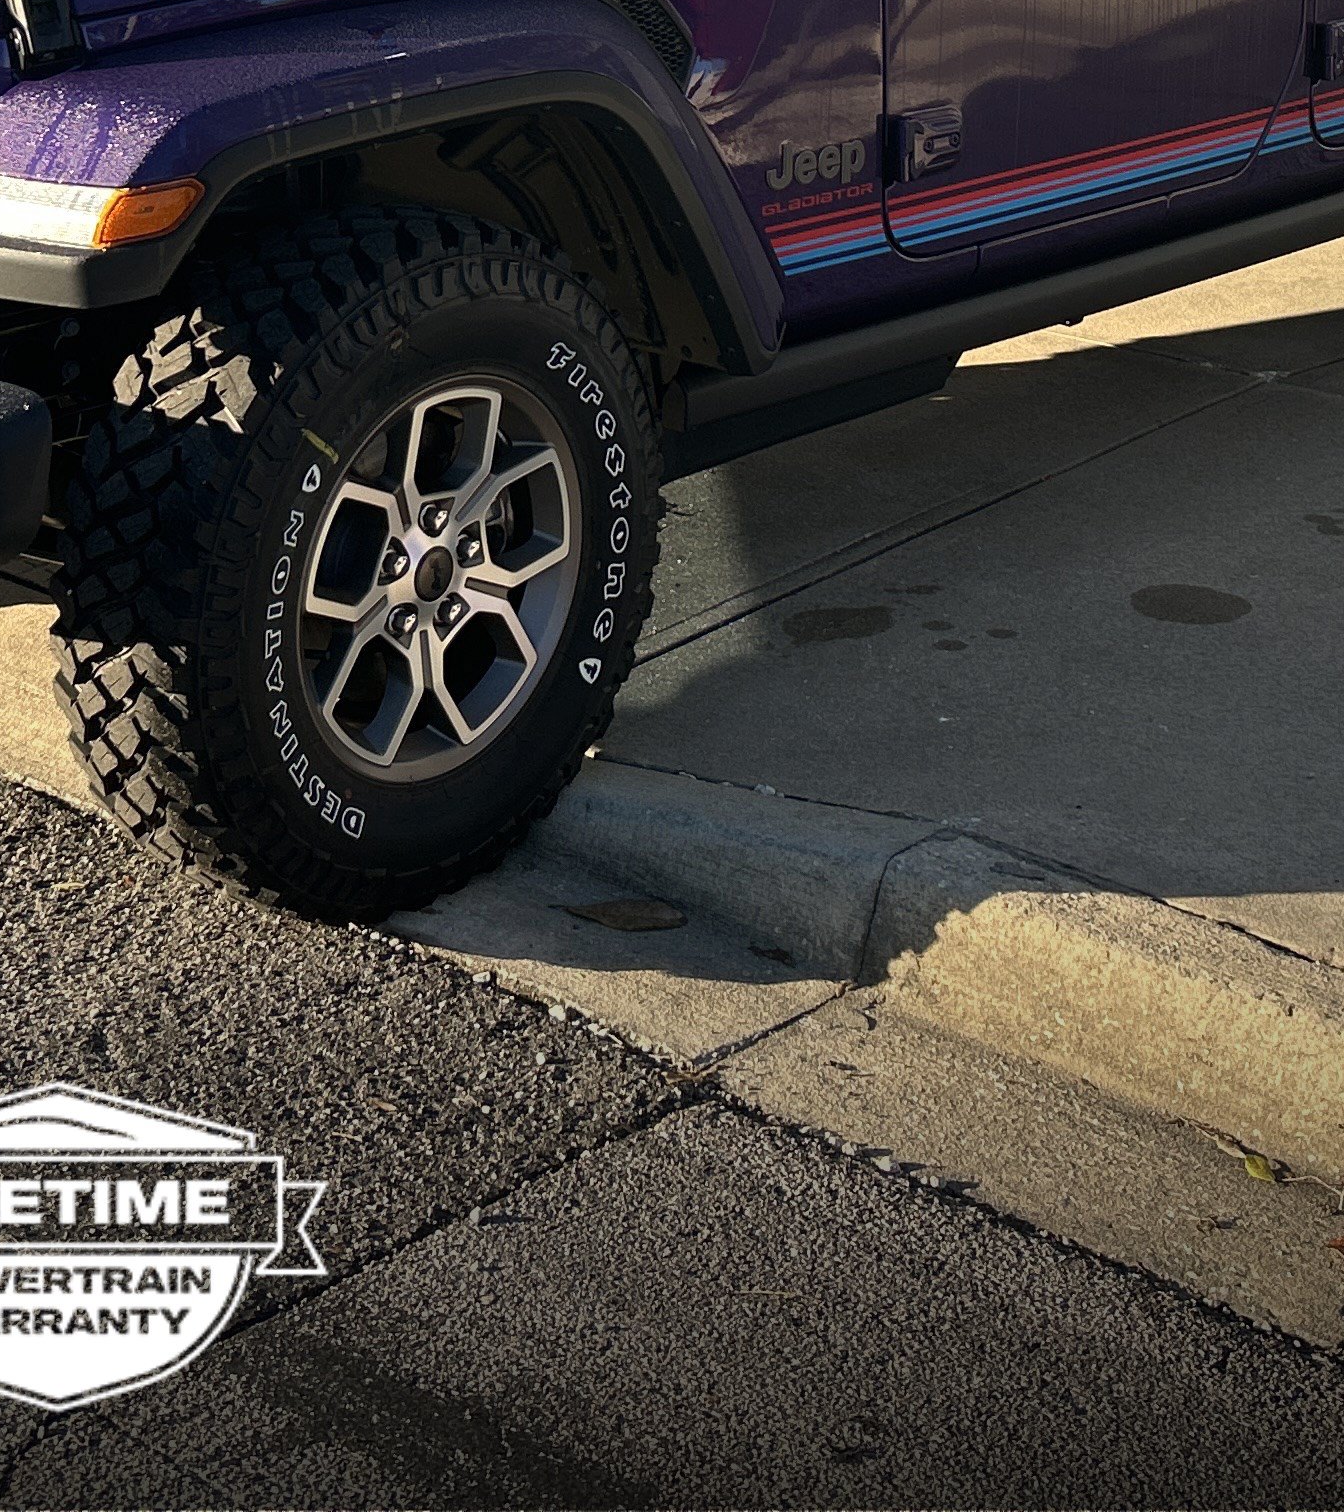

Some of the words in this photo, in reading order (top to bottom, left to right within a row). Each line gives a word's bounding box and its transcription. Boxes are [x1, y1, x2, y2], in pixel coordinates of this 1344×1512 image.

[761, 183, 874, 217] GLADIATOR
[766, 139, 866, 190] Jeep
[546, 341, 633, 643] Firestone
[265, 509, 367, 839] DESTINATION
